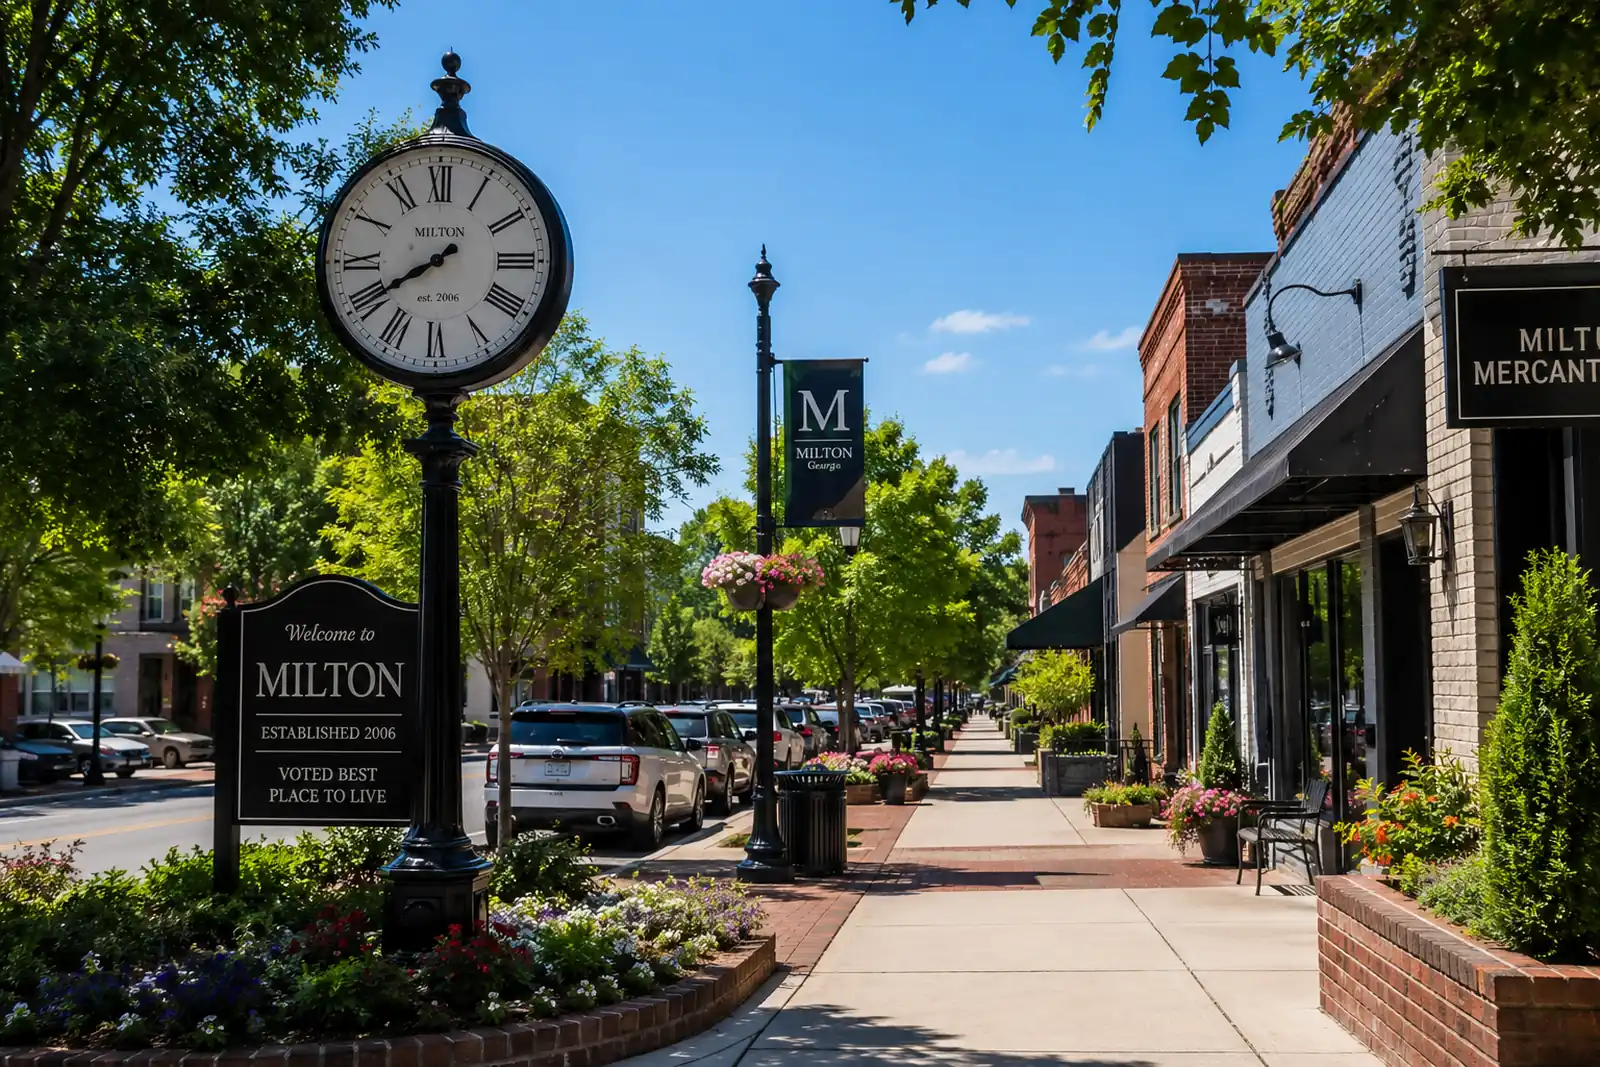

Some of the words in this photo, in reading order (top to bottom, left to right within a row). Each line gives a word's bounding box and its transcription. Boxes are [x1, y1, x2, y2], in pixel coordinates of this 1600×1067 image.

[385, 174, 419, 216] XI
[427, 166, 453, 203] XII
[465, 176, 491, 212] I
[354, 206, 393, 237] X
[414, 226, 465, 238] MILTON
[487, 206, 526, 237] II
[343, 250, 381, 272] IX
[496, 251, 535, 271] III
[416, 293, 433, 303] est.
[435, 292, 460, 302] 2006
[482, 281, 526, 320] IIII
[379, 305, 413, 350] VII
[426, 320, 447, 358] VI
[465, 313, 490, 349] V
[1519, 326, 1600, 352] MILT
[1473, 358, 1600, 386] MERCANT
[797, 389, 851, 432] M
[796, 446, 853, 459] MILTON
[284, 623, 356, 642] Welcome
[360, 627, 376, 642] to
[255, 662, 405, 698] MILTON
[260, 726, 360, 740] ESTABLISHED
[364, 726, 396, 740] 2006
[278, 767, 333, 782] VOTED
[338, 767, 378, 782] BEST
[269, 788, 319, 803] PLACE
[323, 788, 346, 803] TO
[350, 789, 387, 804] LIVE
